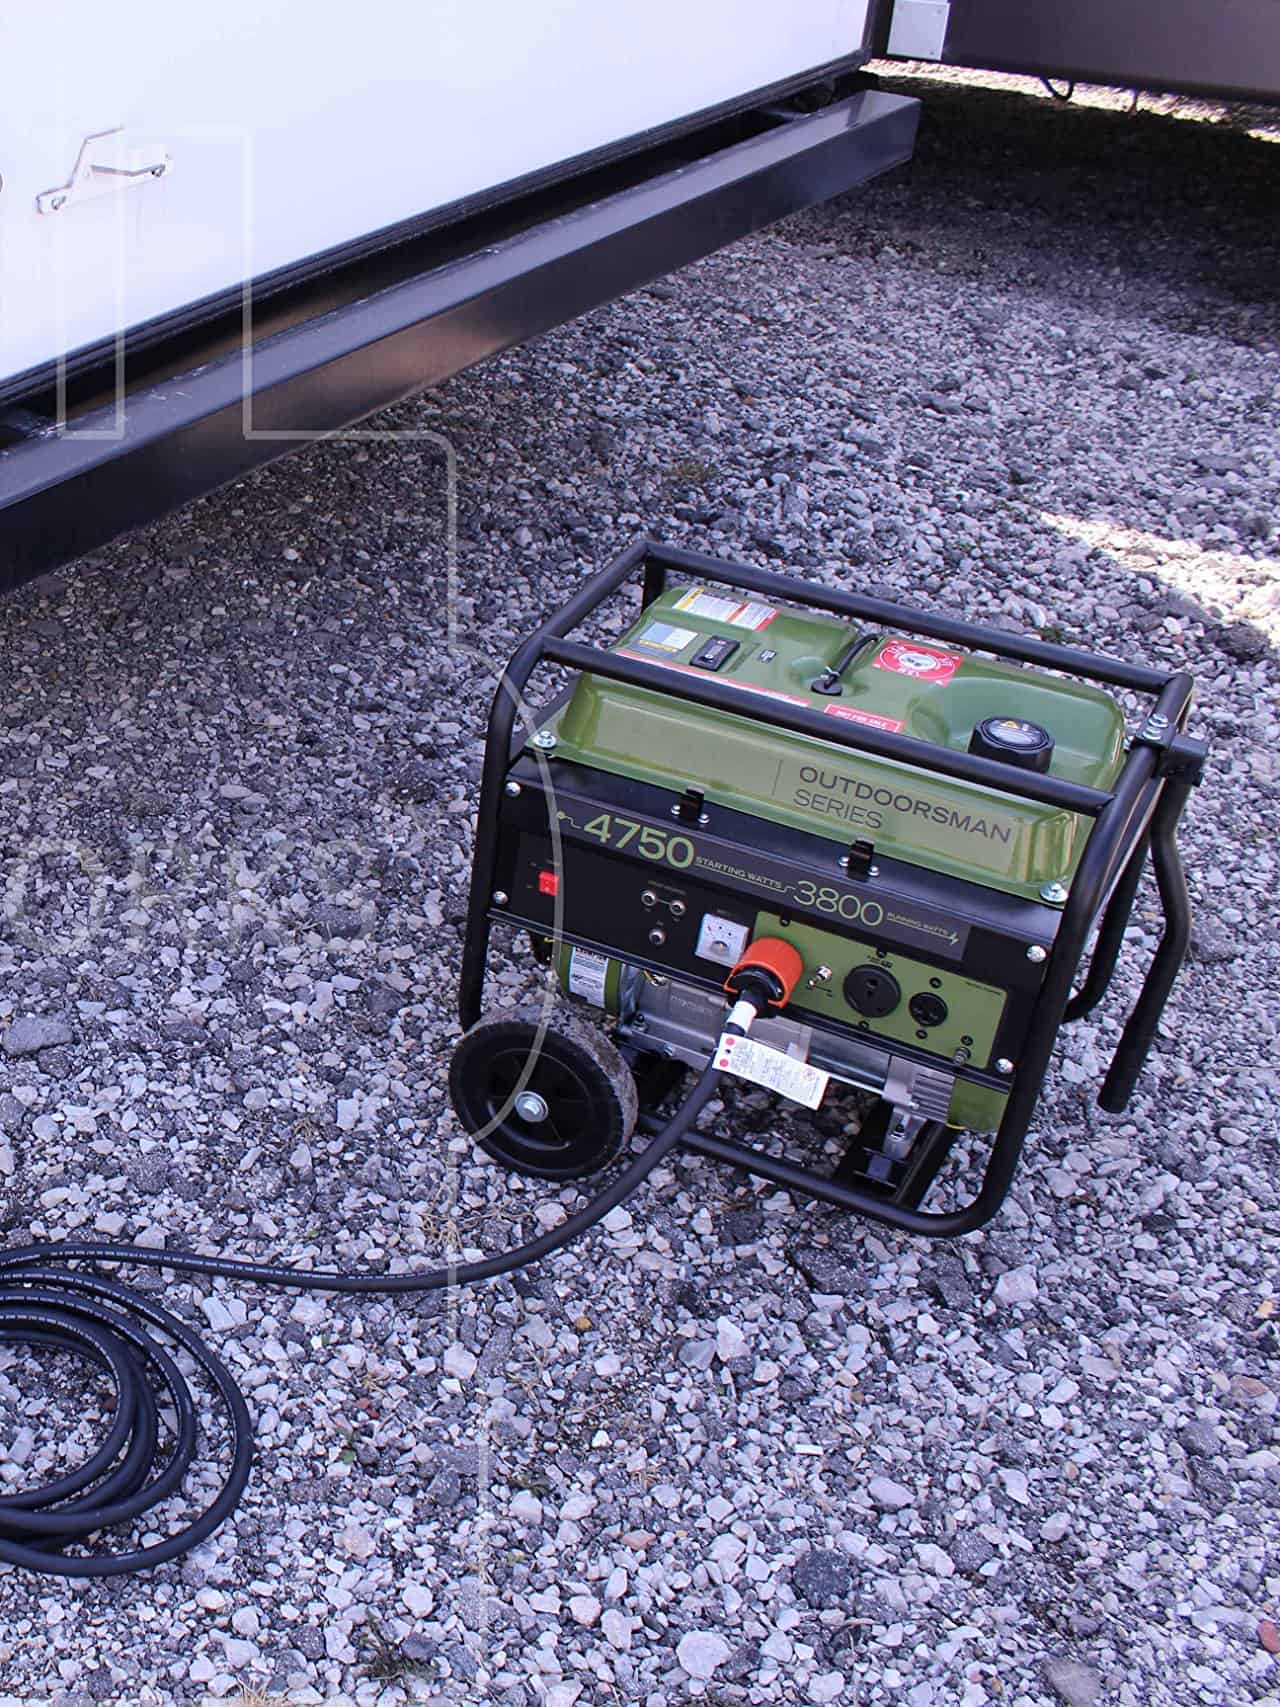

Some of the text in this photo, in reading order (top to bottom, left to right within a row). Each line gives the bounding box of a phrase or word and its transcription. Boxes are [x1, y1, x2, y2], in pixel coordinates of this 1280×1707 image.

[793, 789, 883, 829] SERIES
[800, 766, 1012, 843] OUTDOORSMAN
[583, 814, 695, 868] 4750
[696, 856, 746, 877] STARTING
[747, 872, 782, 889] WATTS
[793, 880, 884, 926] 3800
